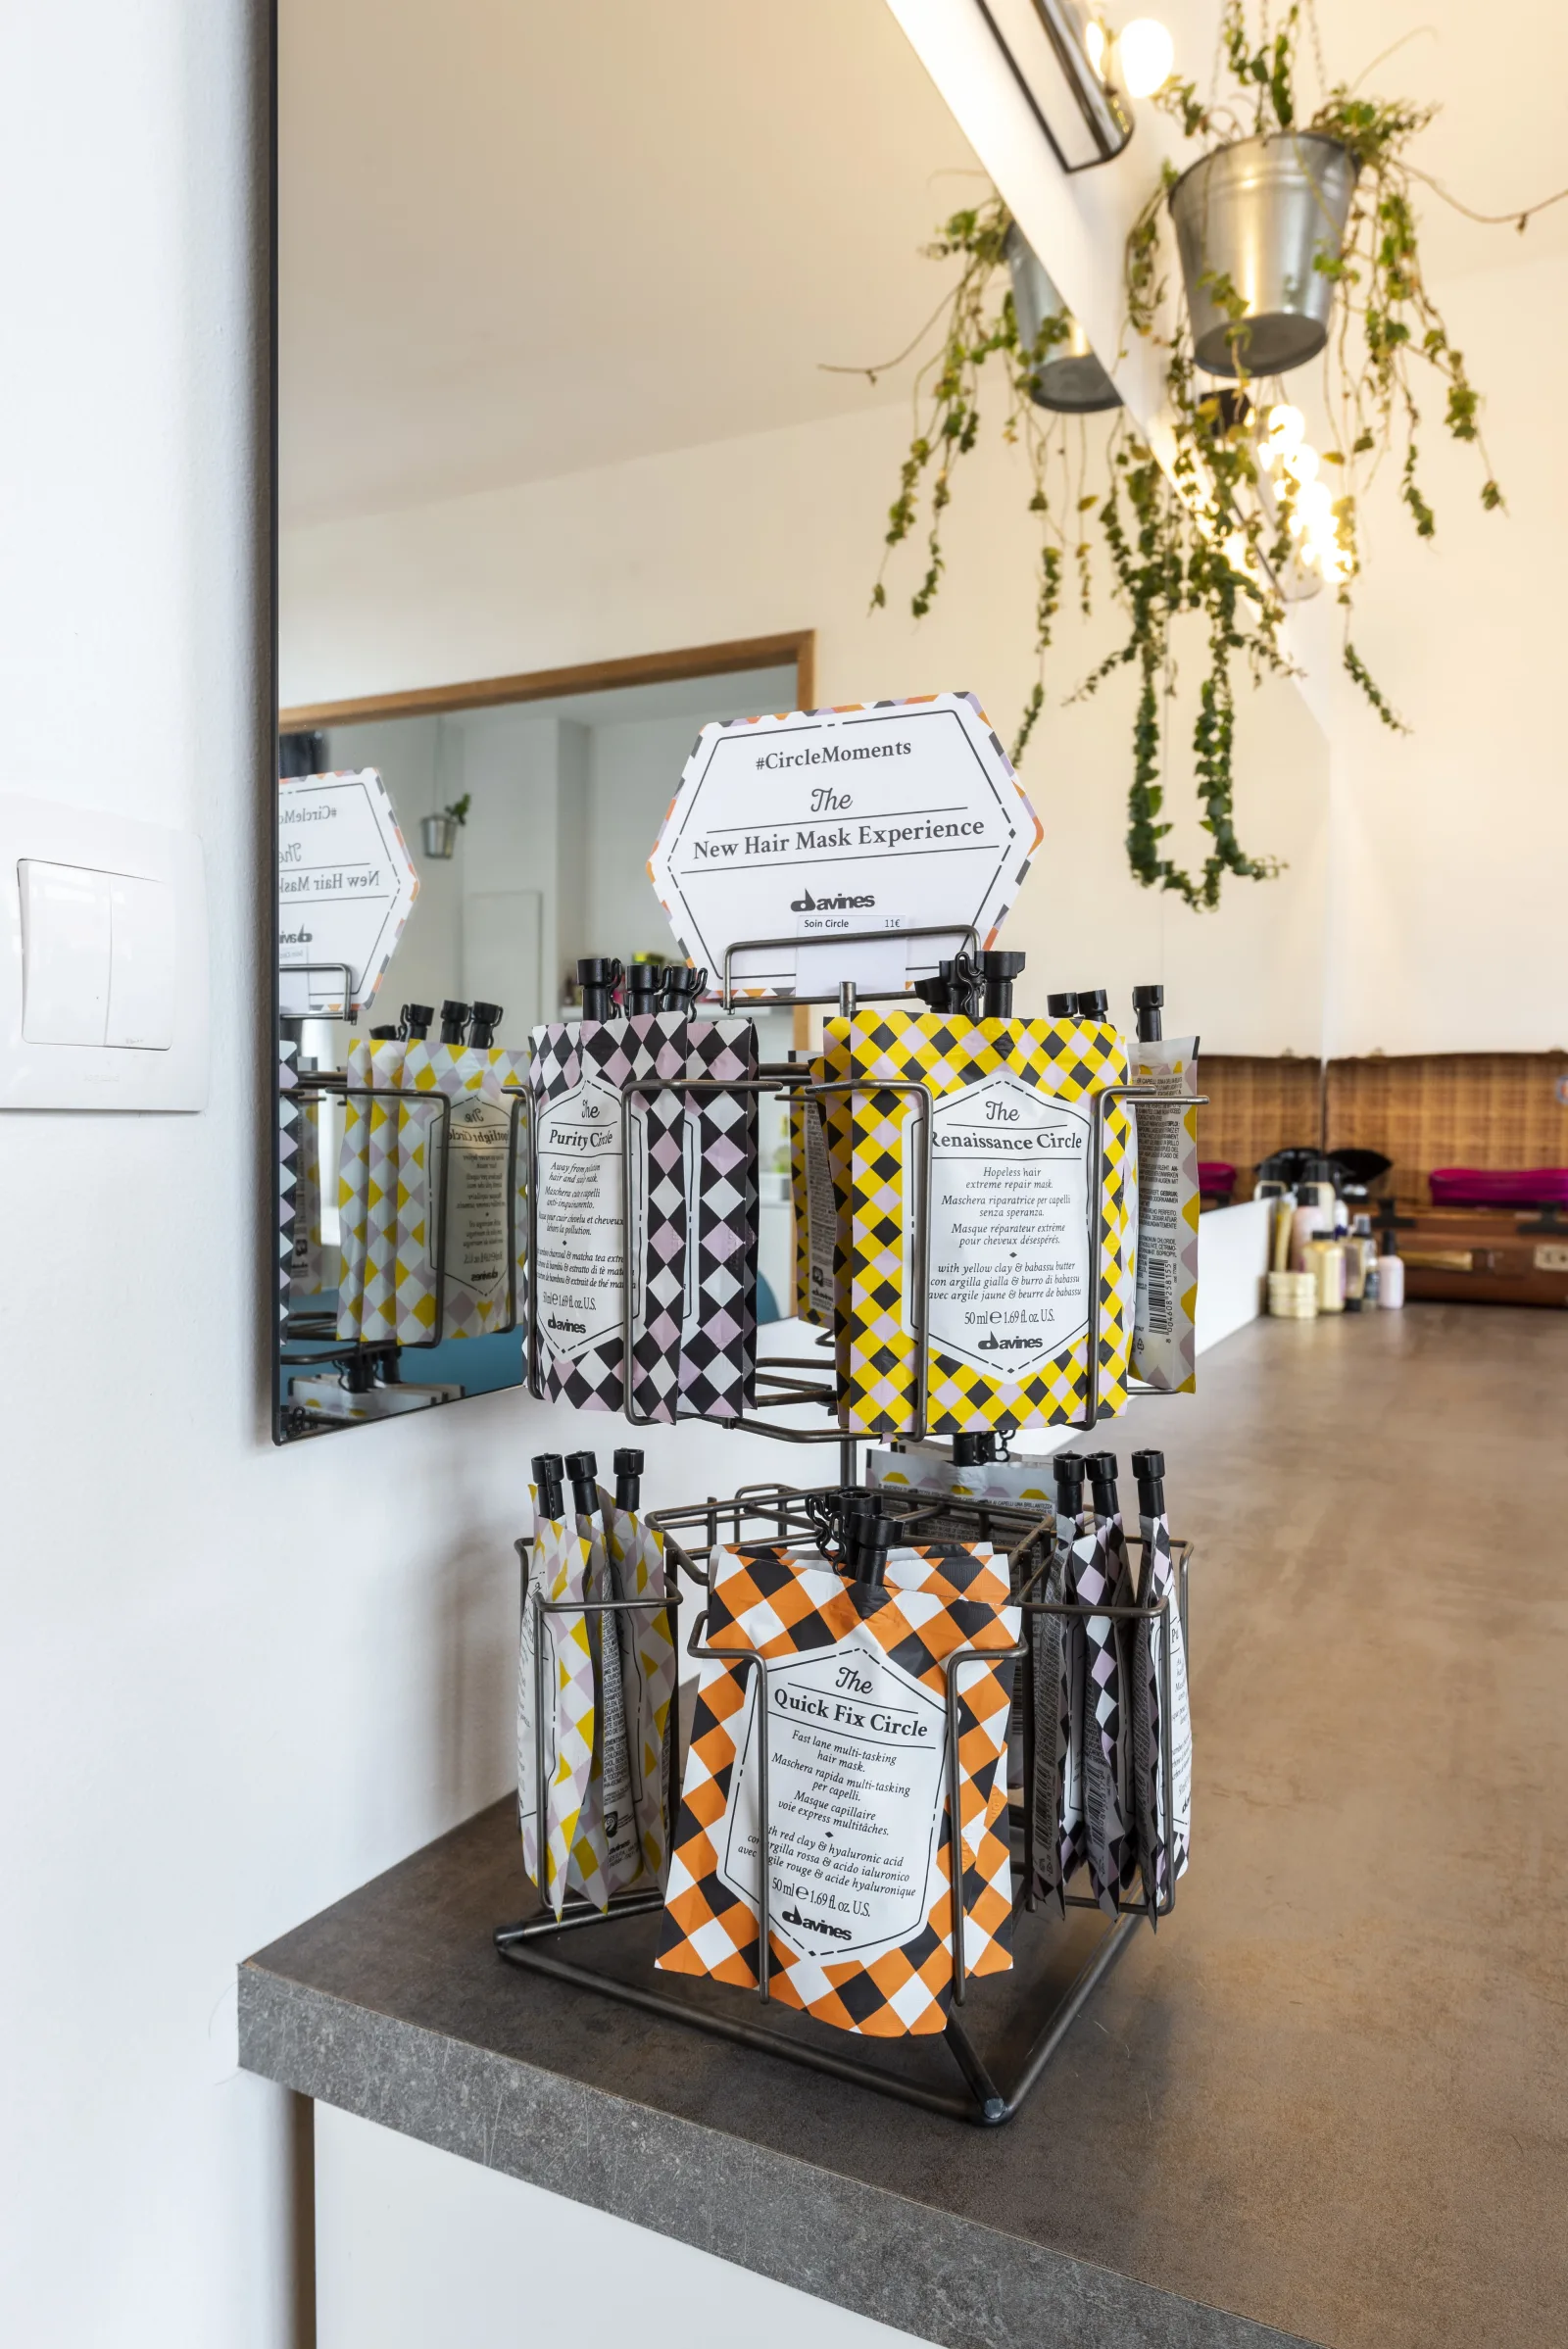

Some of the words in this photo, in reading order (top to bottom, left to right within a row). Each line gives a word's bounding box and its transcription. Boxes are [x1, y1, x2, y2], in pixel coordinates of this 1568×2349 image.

[756, 741, 911, 770] #CircleMoments
[810, 788, 853, 812] The
[694, 841, 738, 859] New
[745, 835, 789, 855] Hair
[796, 828, 852, 850] Mask
[858, 820, 985, 848] Experience
[790, 889, 875, 912] davines
[804, 919, 823, 929] Soin
[824, 919, 849, 929] Circle
[885, 918, 901, 929] 11€
[985, 1101, 1020, 1121] The
[549, 1129, 588, 1150] Purity
[1036, 1132, 1082, 1149] Circle
[551, 1162, 569, 1173] Away
[983, 1166, 1020, 1179] Hopeless
[1023, 1167, 1041, 1177] hair
[549, 1172, 563, 1182] hair
[564, 1174, 576, 1183] and
[965, 1179, 1002, 1189] extreme
[1004, 1179, 1032, 1191] repair
[1033, 1179, 1054, 1189] mask.
[941, 1195, 986, 1205] Maschera
[988, 1195, 1035, 1207] riparatrice
[1037, 1197, 1048, 1207] per
[1049, 1194, 1071, 1206] capelli
[979, 1208, 1004, 1217] senza
[1006, 1208, 1045, 1221] speranza.
[565, 1225, 592, 1236] pollution.
[951, 1223, 988, 1237] Masque
[990, 1223, 1036, 1236] réparateur
[1037, 1222, 1065, 1233] extrême
[958, 1237, 981, 1248] pour
[983, 1236, 1017, 1246] cheveux
[1020, 1235, 1060, 1247] désespérés.
[572, 1251, 593, 1261] matcha
[569, 1263, 590, 1273] estratto
[591, 1264, 598, 1274] di
[599, 1265, 606, 1274] tè
[938, 1262, 959, 1273] with
[961, 1263, 992, 1275] yellow
[994, 1263, 1012, 1275] clay
[1014, 1263, 1023, 1272] &
[1024, 1262, 1054, 1272] babassu
[1055, 1261, 1076, 1271] butter
[571, 1277, 588, 1286] extrait
[590, 1278, 597, 1287] de
[598, 1278, 609, 1288] thé
[930, 1277, 947, 1287] con
[949, 1277, 981, 1290] argilla
[983, 1276, 1008, 1289] gialla
[1010, 1276, 1019, 1286] &
[1020, 1275, 1043, 1286] burro
[1045, 1275, 1053, 1285] di
[1054, 1274, 1080, 1285] babassu
[584, 1297, 596, 1310] U.S.
[929, 1291, 949, 1299] avec
[951, 1290, 978, 1302] argile
[980, 1291, 1005, 1301] jaune
[1008, 1290, 1016, 1299] &
[1017, 1289, 1045, 1299] beurre
[1045, 1289, 1054, 1297] de
[1055, 1287, 1081, 1297] babassu
[547, 1310, 586, 1334] davines
[1004, 1310, 1019, 1324] 1.69
[1041, 1308, 1054, 1322] U.S.
[977, 1330, 1043, 1349] davines
[835, 1667, 873, 1694] The
[774, 1688, 829, 1719] Quick
[834, 1704, 864, 1728] Fix
[870, 1714, 928, 1737] Circle
[792, 1730, 811, 1744] Fast
[812, 1736, 832, 1750] lane
[833, 1739, 898, 1766] multi-tasking
[816, 1750, 837, 1765] hair
[838, 1760, 865, 1773] mask.
[771, 1752, 813, 1775] Maschera
[814, 1767, 844, 1786] rapida
[846, 1776, 911, 1797] multi-tasking
[811, 1781, 828, 1792] per
[829, 1785, 861, 1802] capelli.
[794, 1790, 830, 1810] Masque
[830, 1800, 876, 1821] capillaire
[778, 1800, 797, 1813] voie
[797, 1806, 831, 1824] express
[833, 1816, 890, 1836] multitâches.
[780, 1829, 795, 1842] red
[796, 1833, 816, 1850] clay
[817, 1840, 827, 1851] &
[828, 1843, 881, 1864] hyaluronic
[883, 1855, 904, 1868] acid
[767, 1841, 795, 1856] rgilla
[796, 1850, 820, 1865] rossa
[822, 1857, 831, 1867] &
[833, 1860, 859, 1874] acido
[861, 1867, 910, 1883] ialuronico
[737, 1845, 758, 1858] avec
[786, 1860, 812, 1878] rouge
[814, 1868, 823, 1879] &
[825, 1873, 851, 1886] acide
[852, 1878, 916, 1899] hyaluronique
[809, 1889, 828, 1906] 1.69
[853, 1900, 871, 1918] U.S.
[782, 1904, 853, 1941] davines
